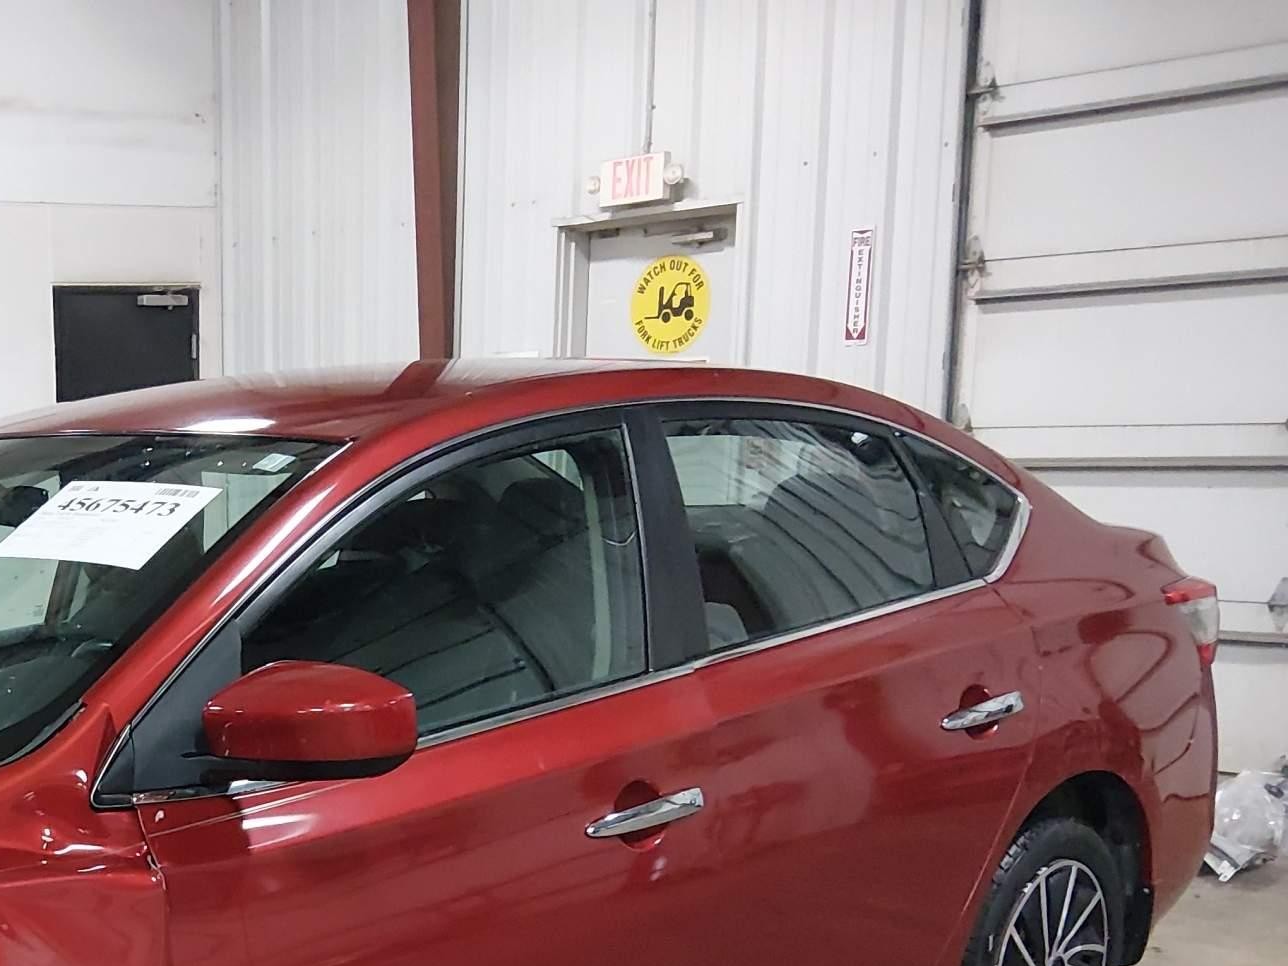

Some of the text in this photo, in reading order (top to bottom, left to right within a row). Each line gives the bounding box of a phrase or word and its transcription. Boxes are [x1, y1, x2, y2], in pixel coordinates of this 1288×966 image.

[611, 156, 654, 200] EXIT
[853, 236, 871, 247] FIRE
[637, 259, 705, 294] WATCH OUT FOR
[852, 249, 864, 334] EXTINGUISHER
[635, 316, 703, 351] FORK LIFT TRUCKS
[58, 496, 181, 517] 45675473
